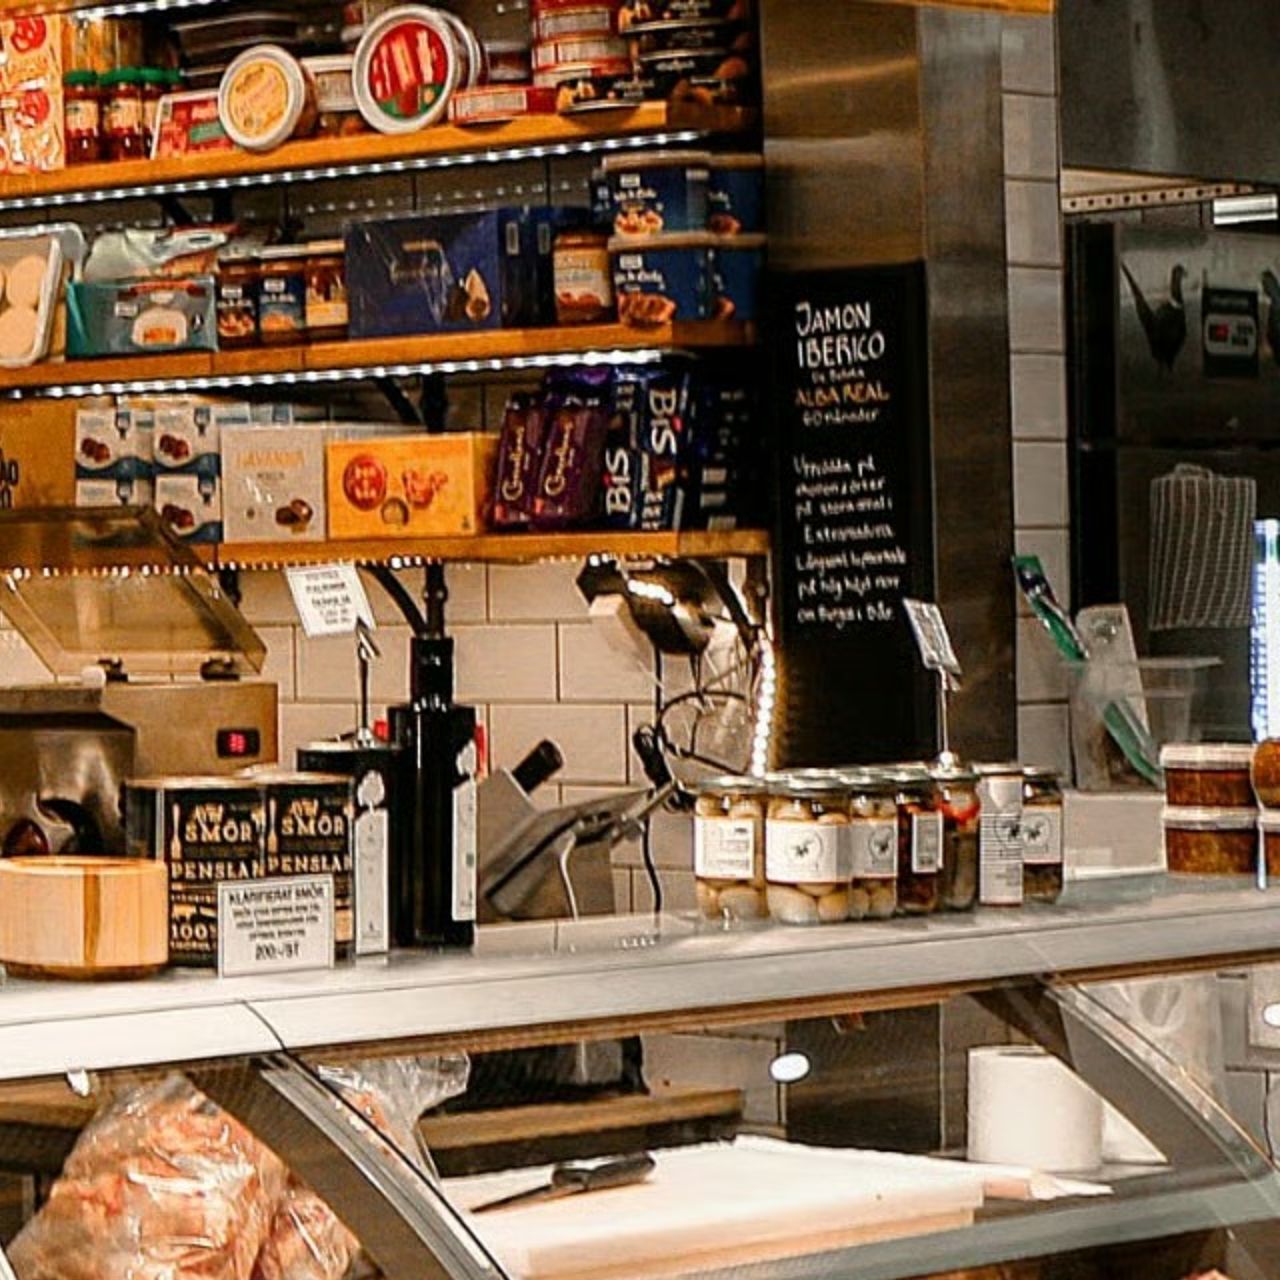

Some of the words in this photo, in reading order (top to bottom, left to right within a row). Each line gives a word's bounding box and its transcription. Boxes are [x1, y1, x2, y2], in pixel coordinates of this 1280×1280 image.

[796, 301, 871, 336] JAMON
[797, 331, 886, 368] IBERICO
[184, 817, 253, 843] SMÖR
[281, 811, 345, 836] SMÖR
